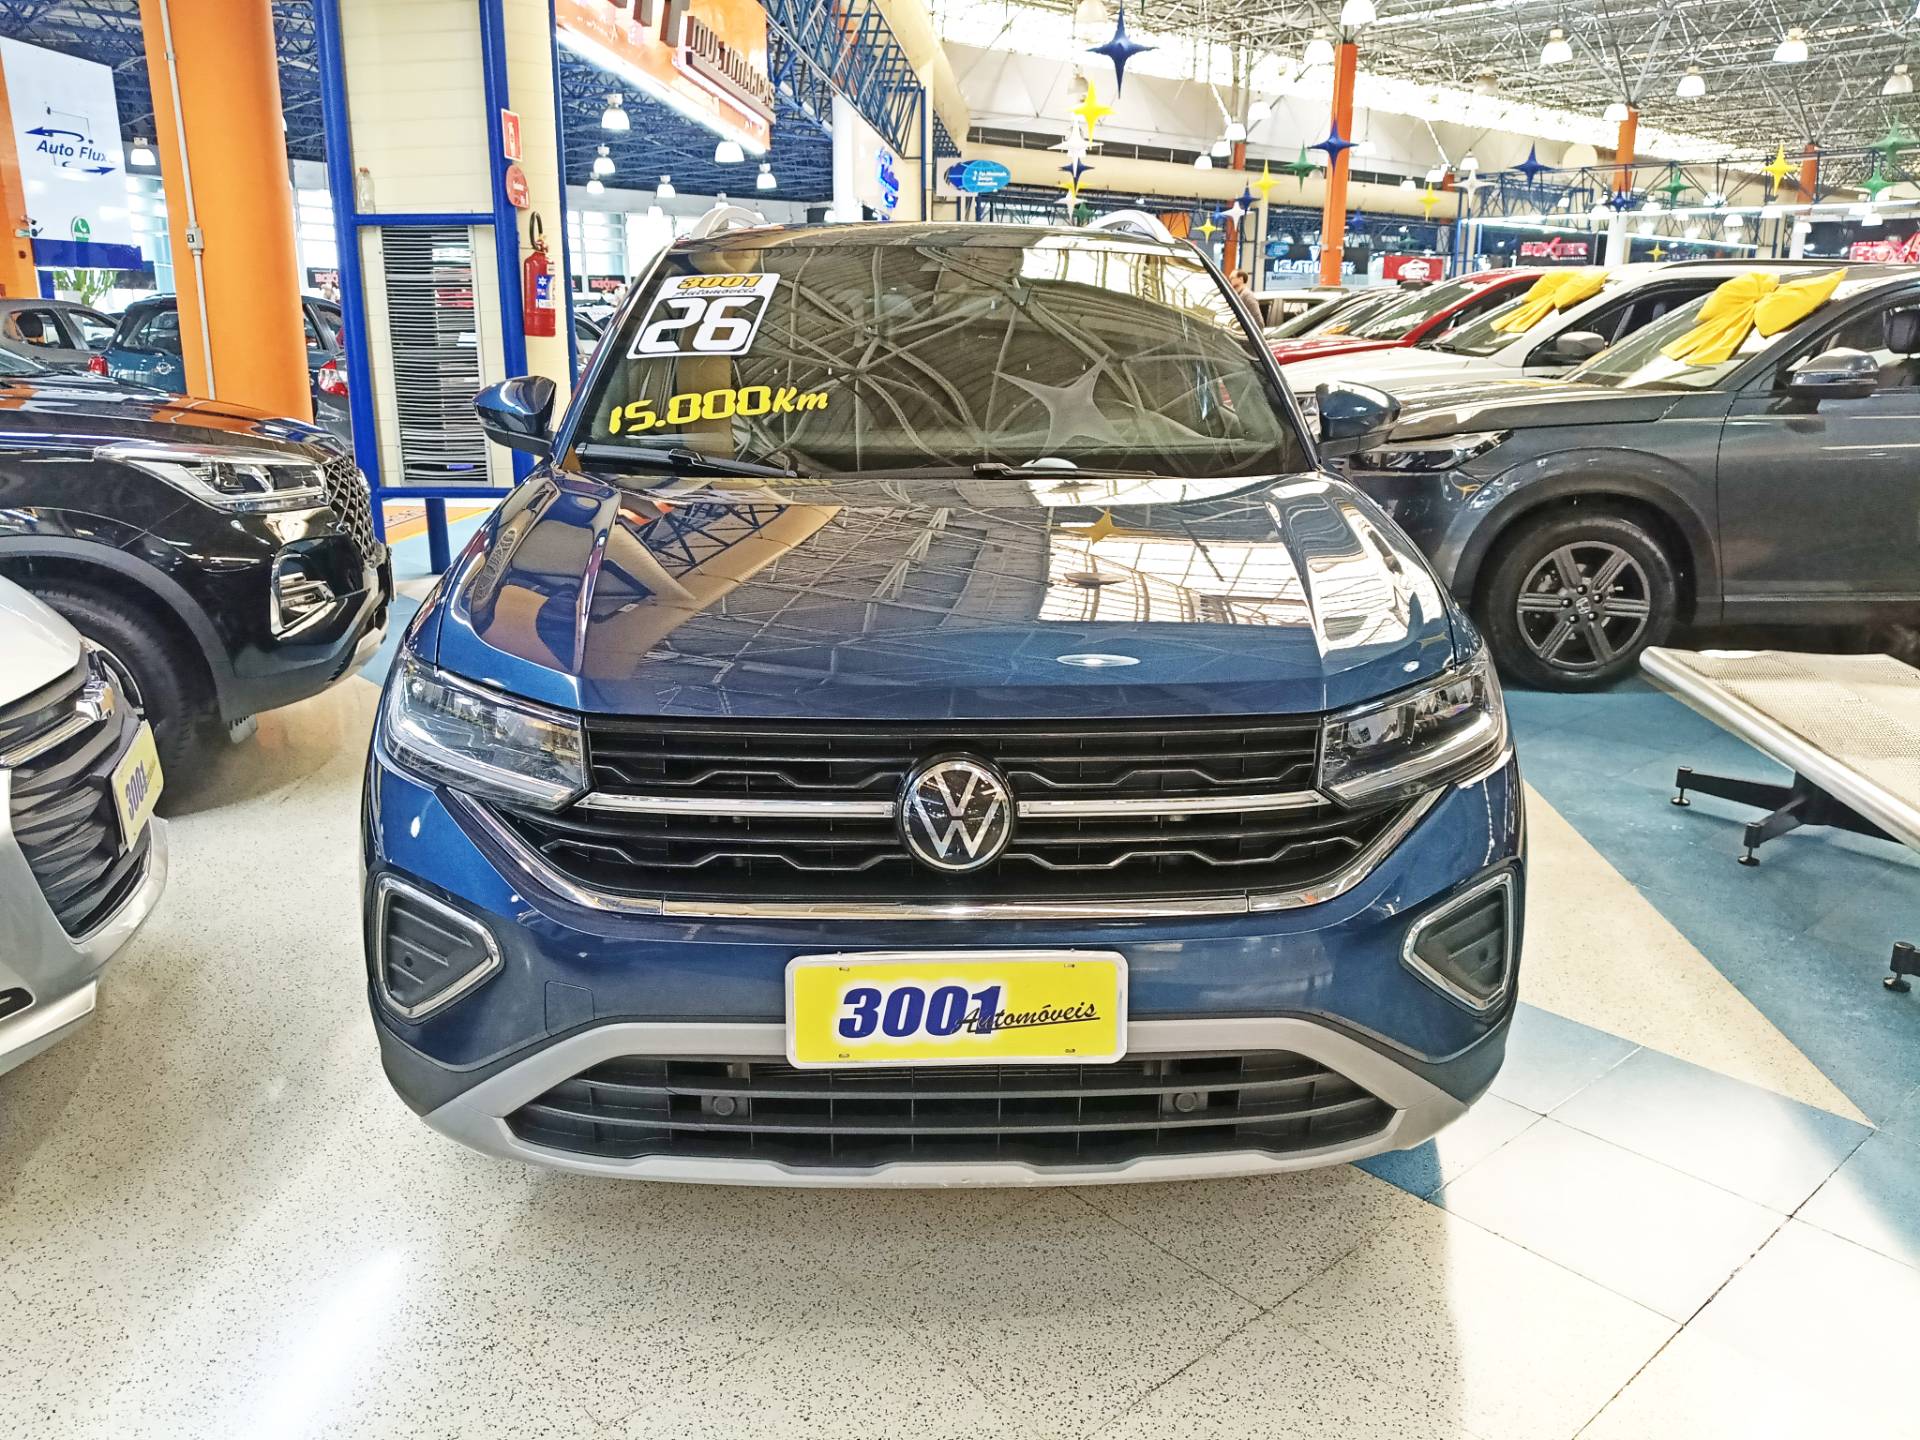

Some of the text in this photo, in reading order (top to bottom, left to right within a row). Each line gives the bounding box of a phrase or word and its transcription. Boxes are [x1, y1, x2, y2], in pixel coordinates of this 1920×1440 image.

[36, 140, 74, 157] Auto
[677, 274, 763, 290] 3001
[638, 296, 757, 352] 26
[838, 985, 1101, 1039] 3001 Automóveis
